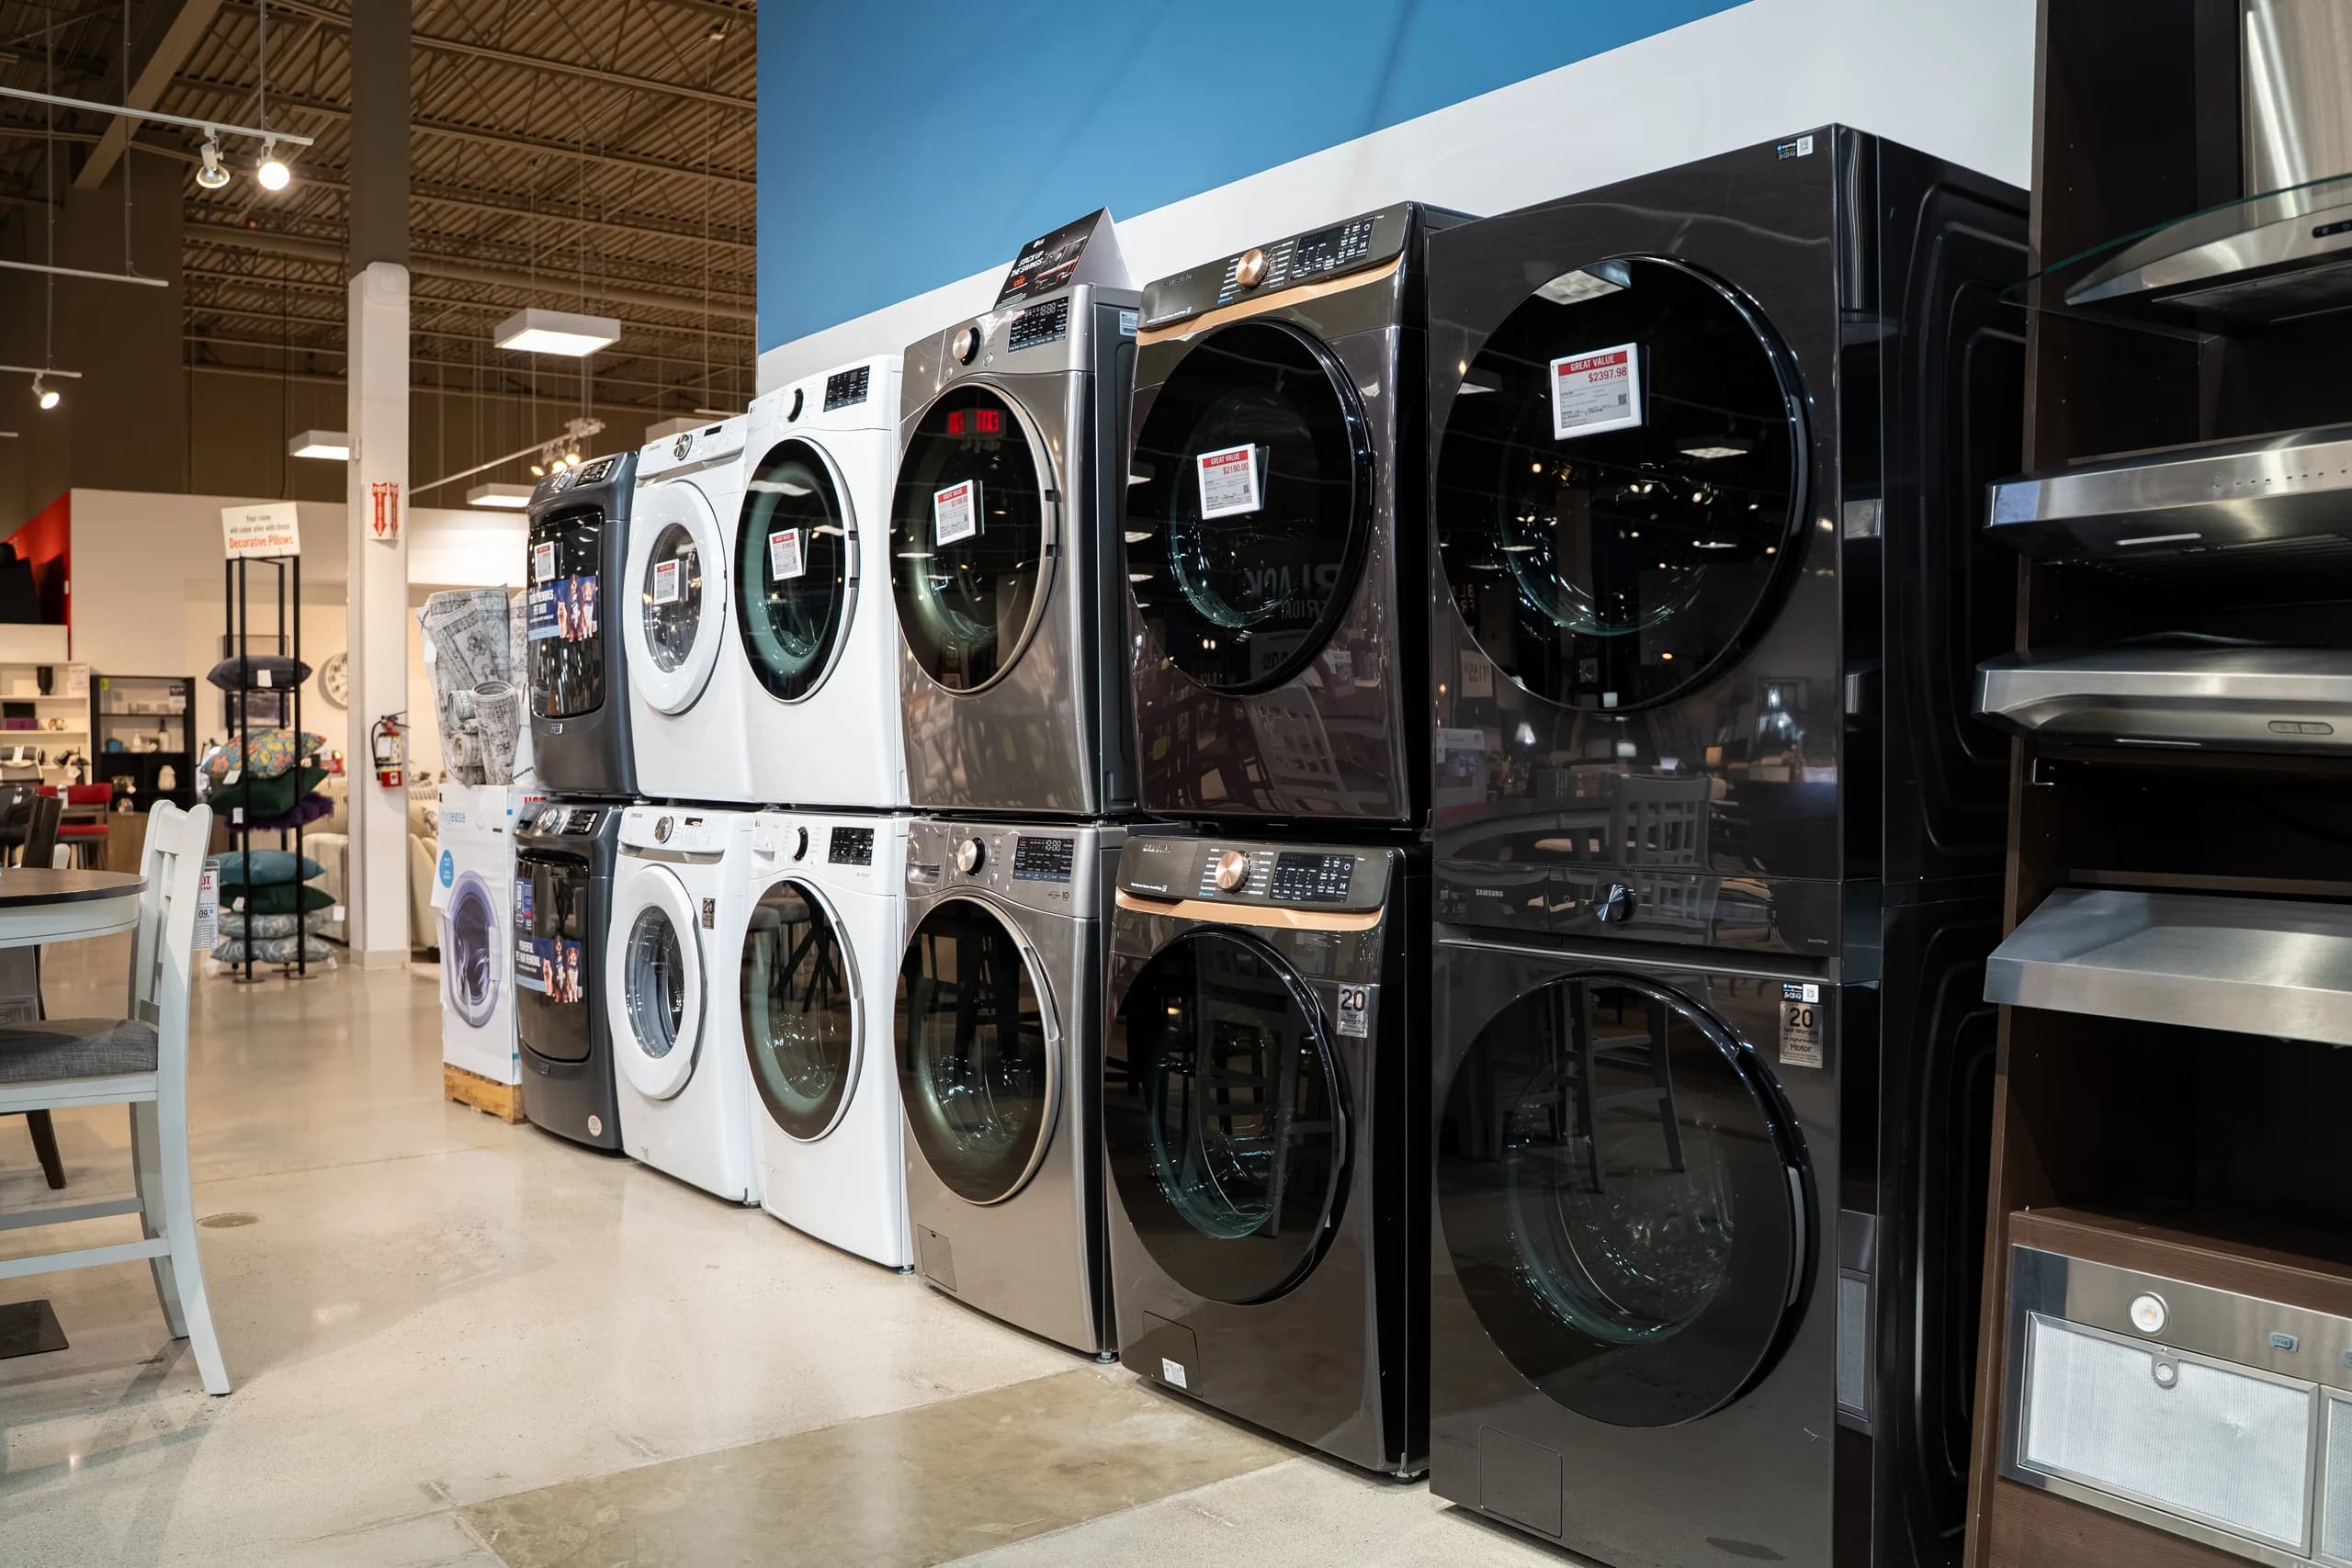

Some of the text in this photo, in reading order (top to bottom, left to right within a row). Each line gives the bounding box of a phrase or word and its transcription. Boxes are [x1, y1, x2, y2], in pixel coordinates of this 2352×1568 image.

[1570, 354, 1615, 372] GREAT VALUE
[1588, 367, 1627, 383] $2397.98
[229, 535, 294, 549] Decorative Pillows
[1476, 888, 1504, 897] SAMSUNG
[703, 900, 714, 914] 20
[1340, 988, 1366, 1012] 20
[1789, 1007, 1814, 1028] 20
[1789, 1043, 1812, 1053] Motor
